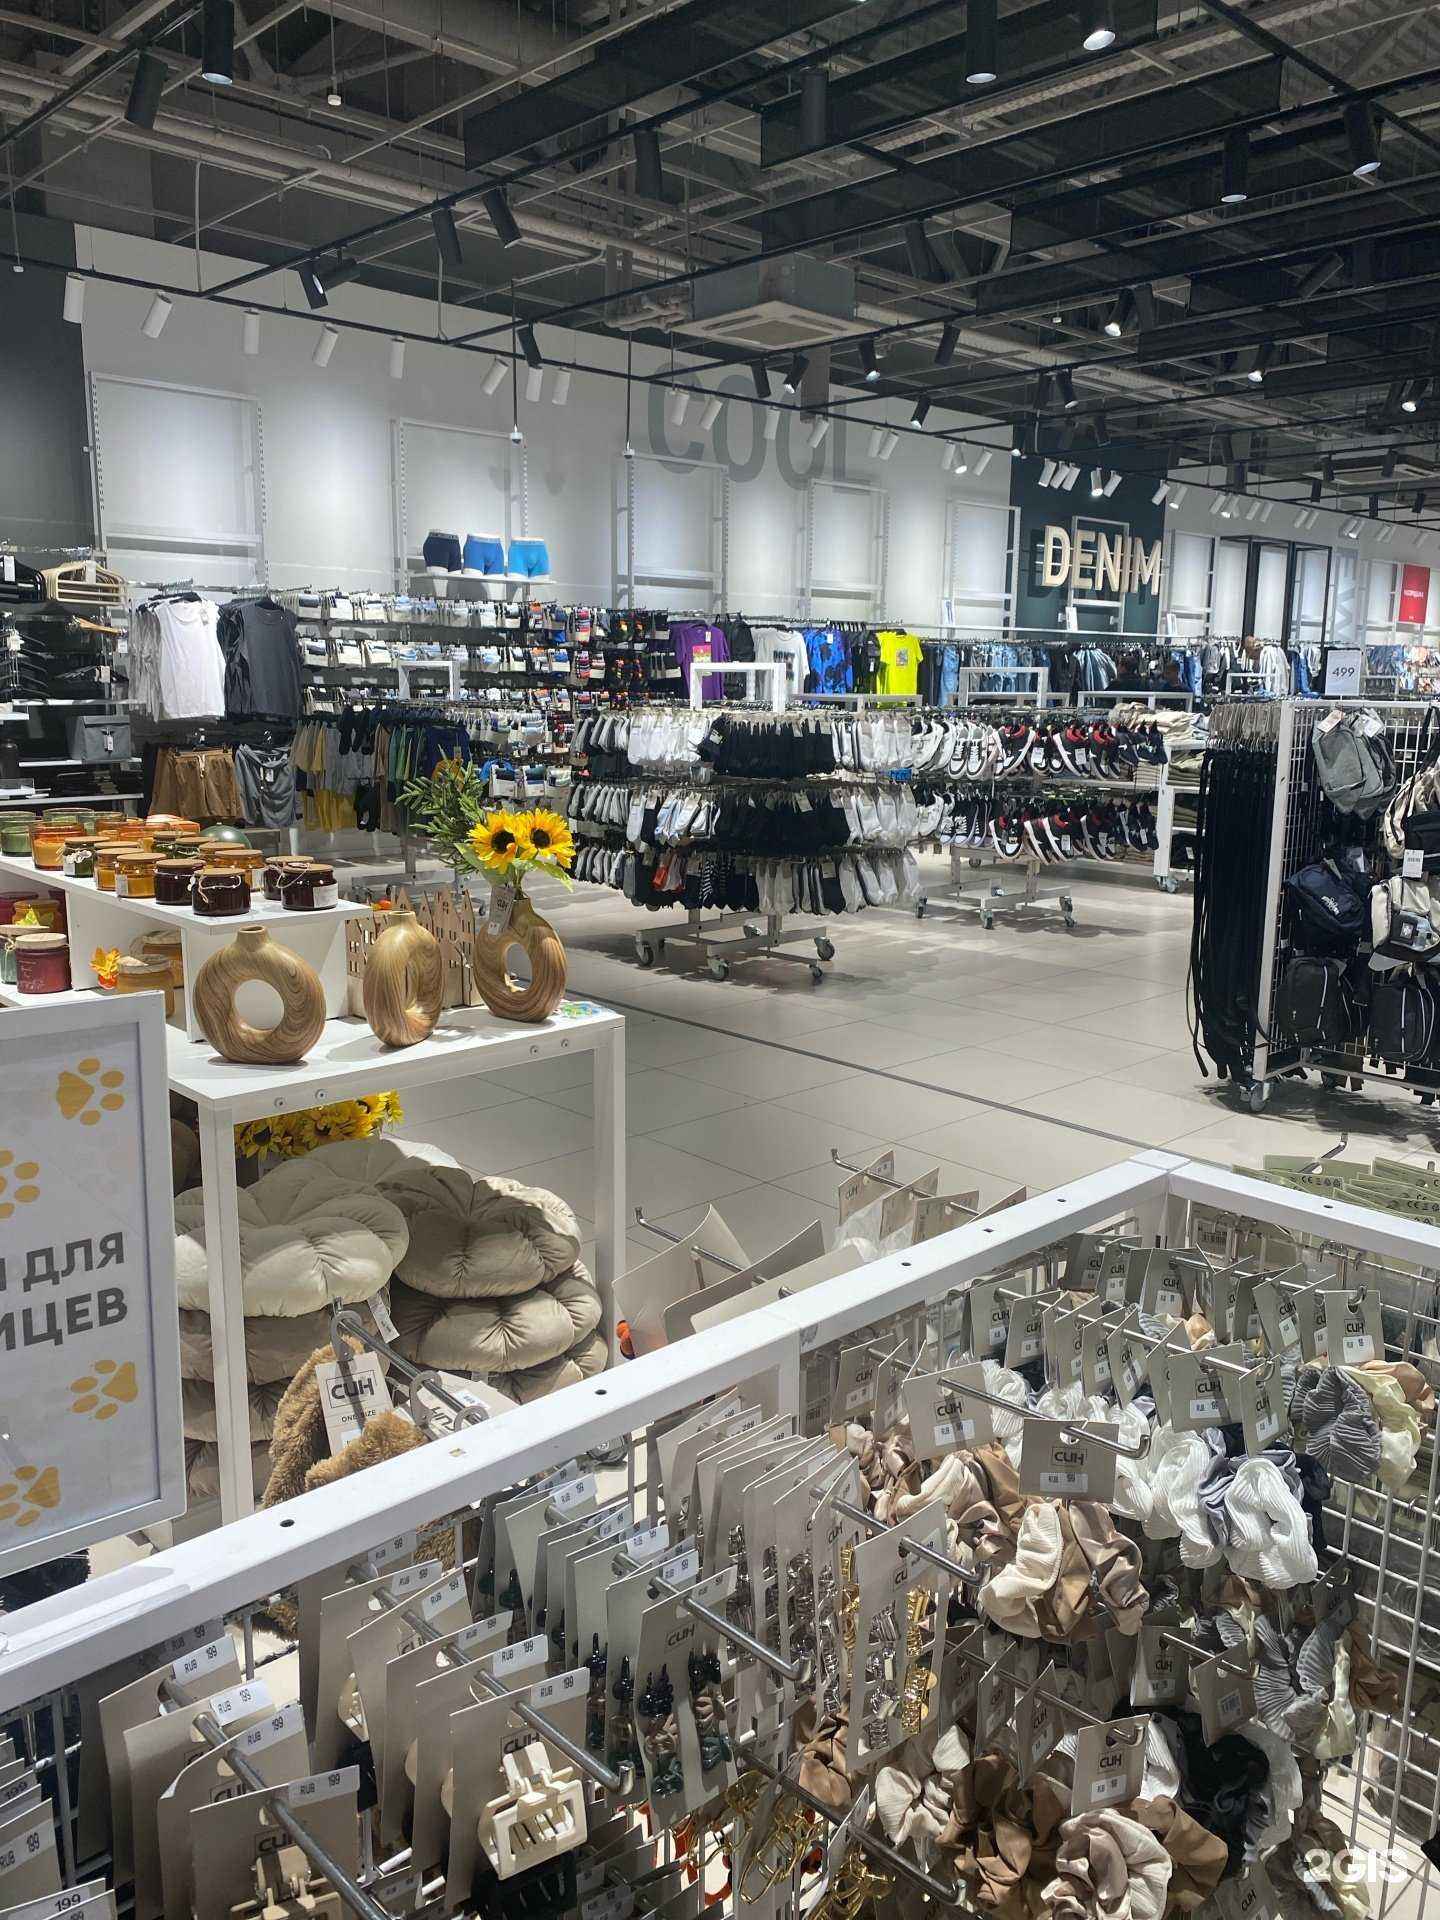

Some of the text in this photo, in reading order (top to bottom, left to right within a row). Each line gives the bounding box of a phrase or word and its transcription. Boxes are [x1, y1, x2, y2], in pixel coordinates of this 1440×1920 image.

[1042, 525, 1162, 596] DENIM
[1332, 667, 1355, 678] 499
[22, 1231, 125, 1293] ДЛЯ
[502, 1640, 534, 1664] RUB 199
[184, 1658, 197, 1674] RUB
[563, 1675, 574, 1690] 199
[218, 1700, 232, 1714] RUB
[247, 1716, 284, 1745] RUB 199
[300, 1773, 341, 1795] RUB 199
[26, 1832, 40, 1852] 199
[55, 1894, 81, 1912] 199
